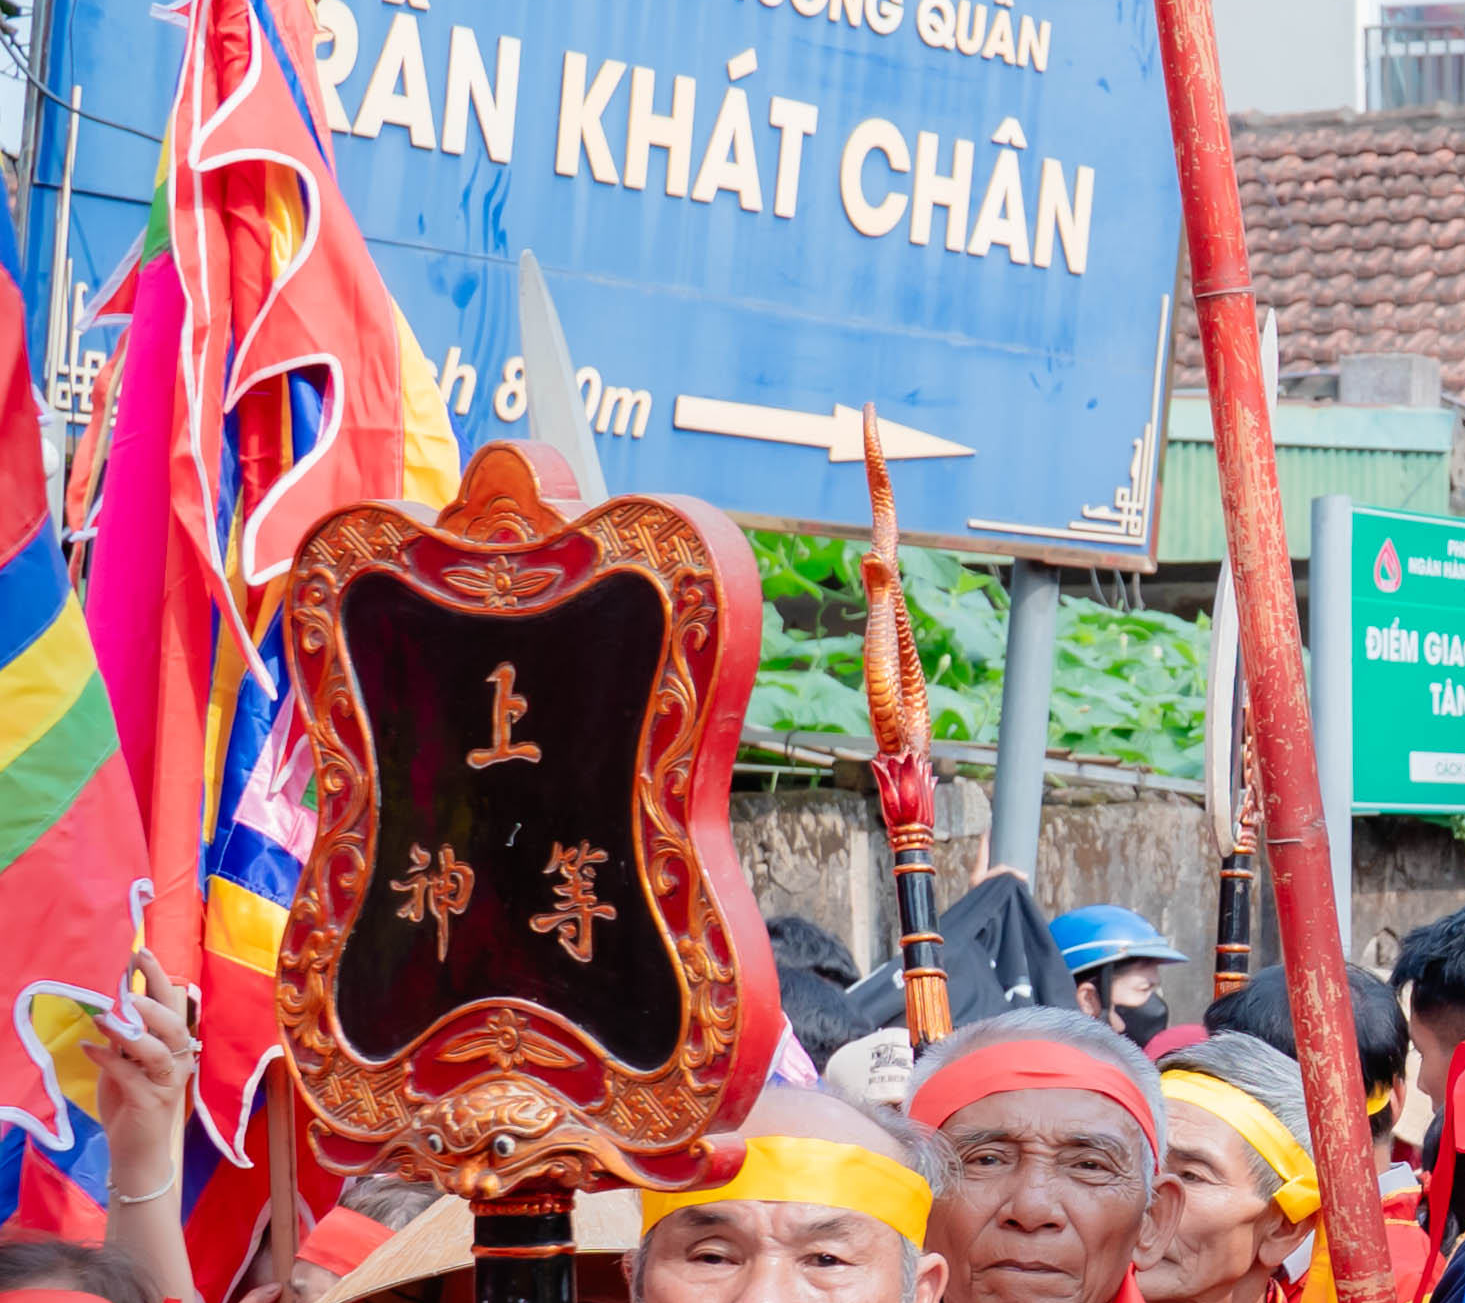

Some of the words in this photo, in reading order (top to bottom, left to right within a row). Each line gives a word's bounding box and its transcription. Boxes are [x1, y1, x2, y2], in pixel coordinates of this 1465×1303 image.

[555, 47, 818, 219] KHÁT
[839, 116, 1095, 276] CHÂN
[466, 661, 543, 770] 上
[390, 841, 475, 963] 神
[529, 838, 616, 964] 等
